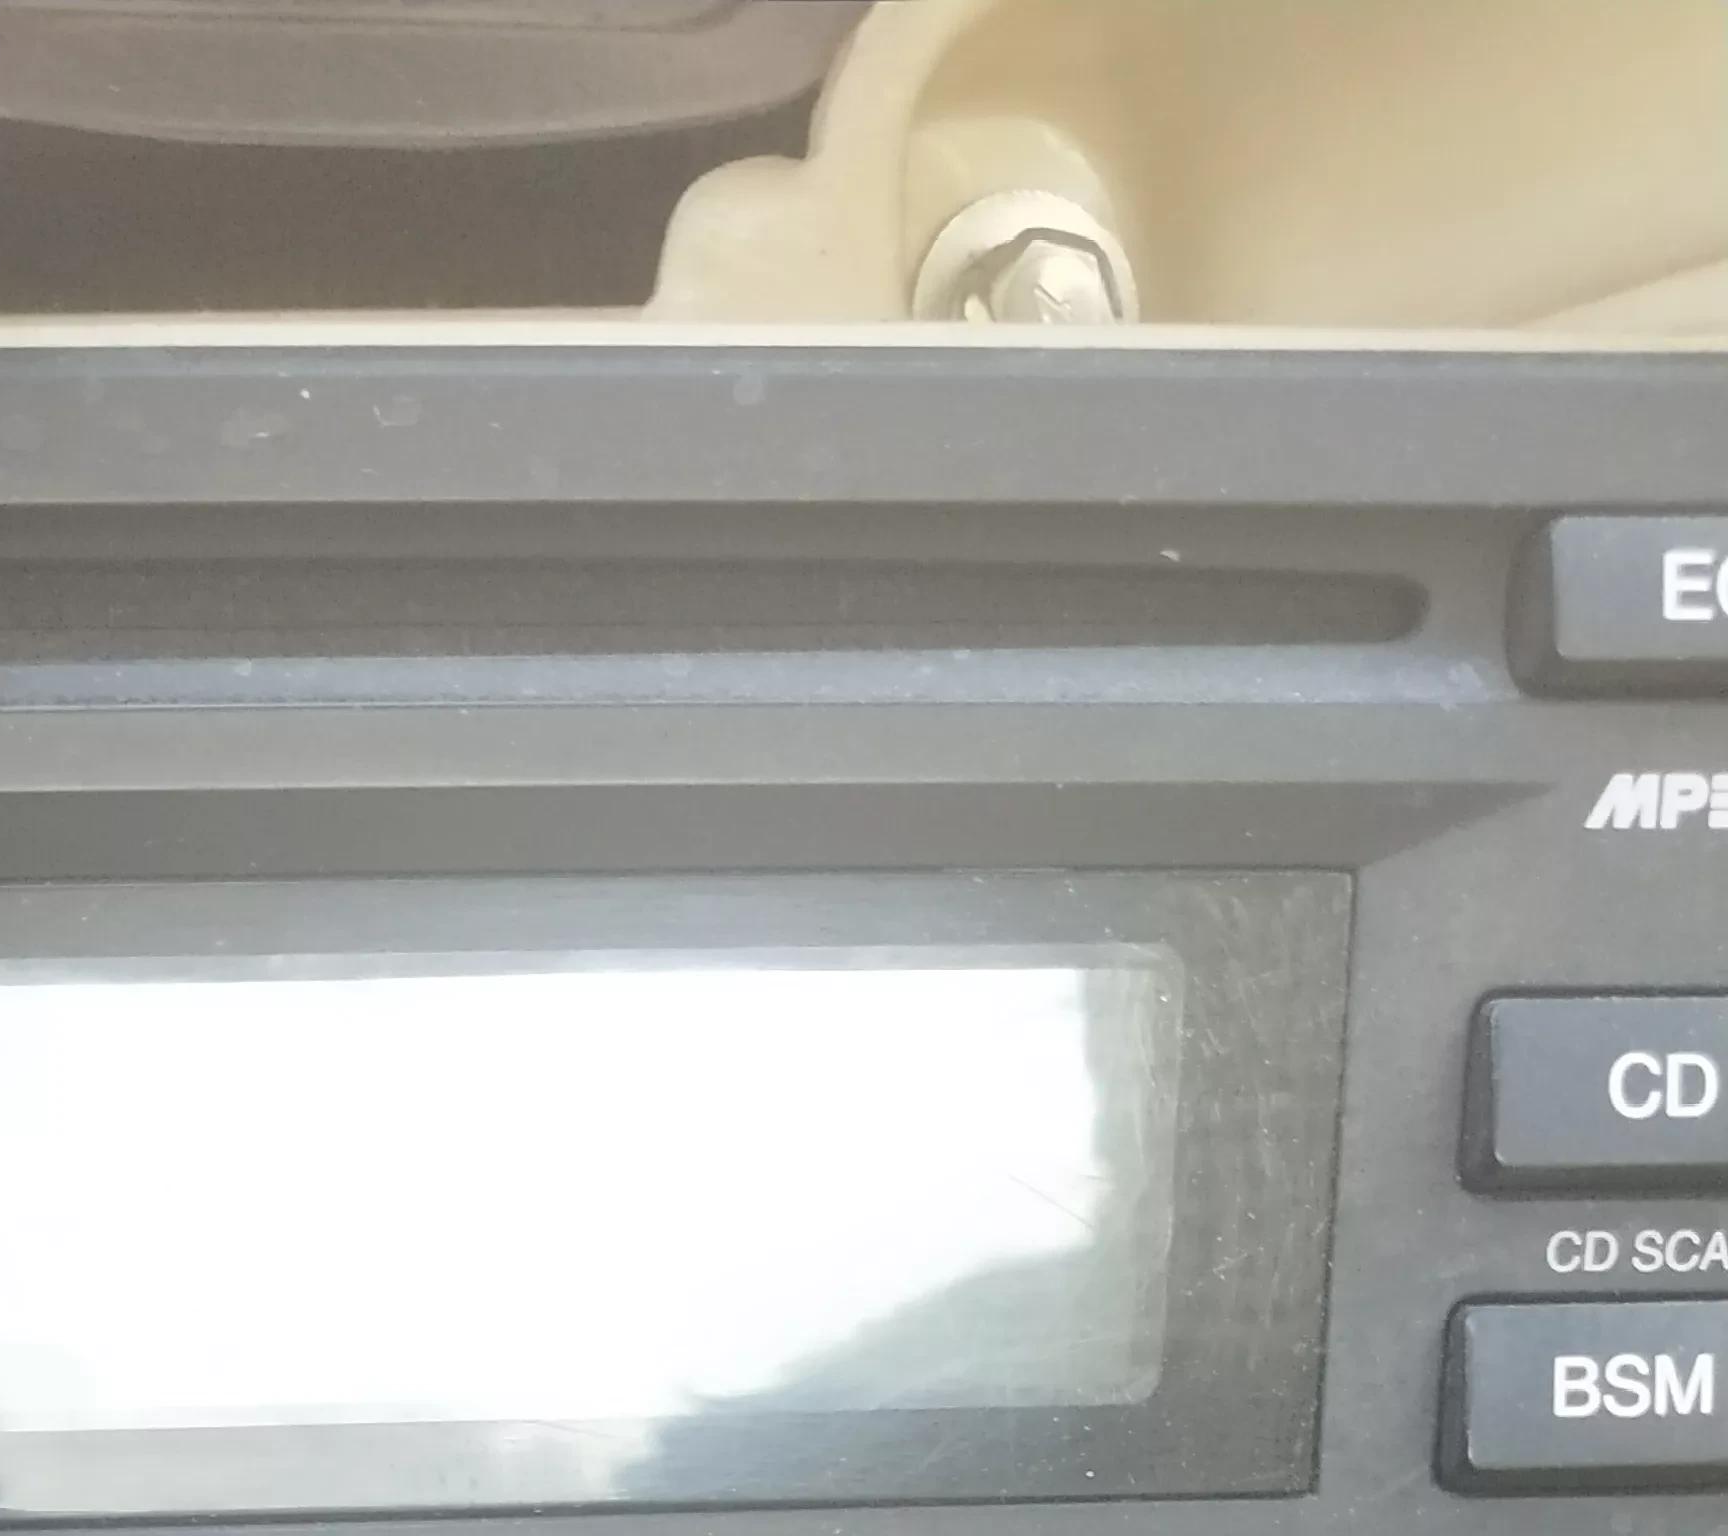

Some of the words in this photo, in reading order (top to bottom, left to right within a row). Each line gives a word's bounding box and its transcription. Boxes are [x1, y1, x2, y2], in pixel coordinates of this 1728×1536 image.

[1663, 549, 1728, 621] E
[1608, 1051, 1719, 1119] CD
[1546, 1230, 1619, 1273] CD
[1553, 1353, 1714, 1418] BSM
